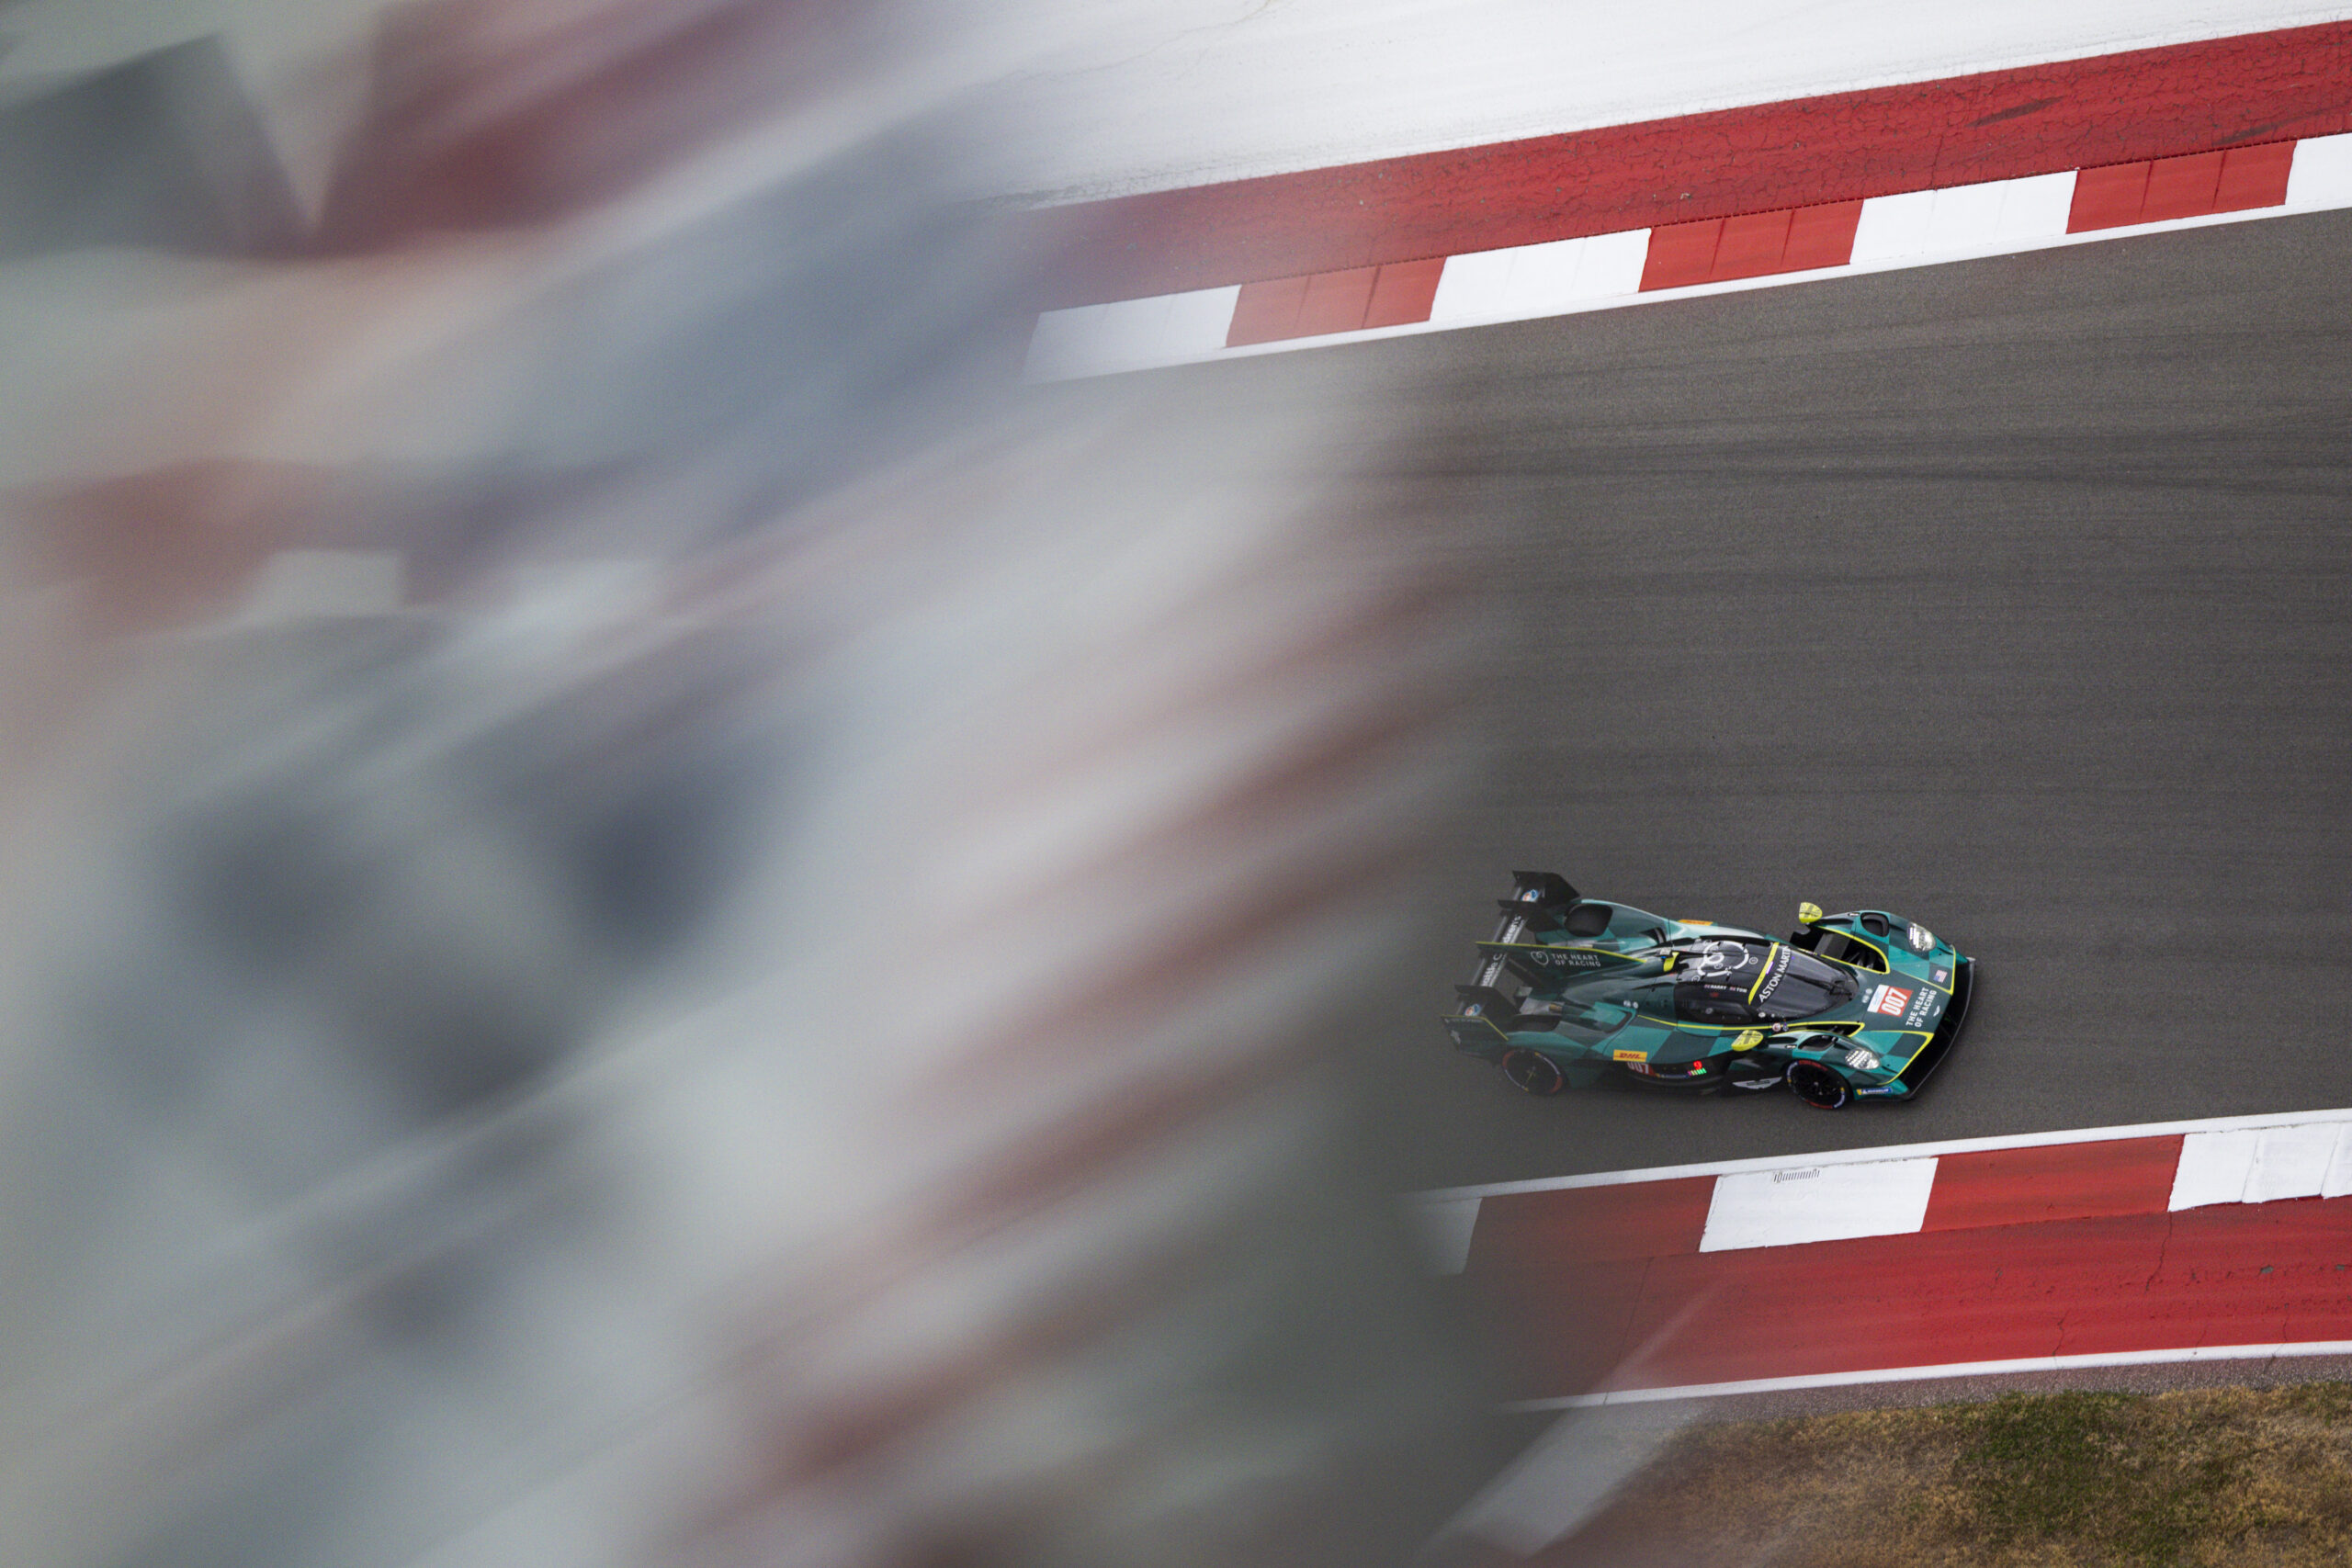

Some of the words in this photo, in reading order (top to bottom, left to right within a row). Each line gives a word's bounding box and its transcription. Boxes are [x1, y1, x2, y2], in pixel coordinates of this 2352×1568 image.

[1568, 960, 1601, 968] RACING
[1758, 974, 1782, 1003] ASTON
[1881, 987, 1908, 1016] 007
[1905, 1011, 1918, 1026] THE
[1913, 987, 1929, 1010] HEART
[1914, 1015, 1924, 1028] OF
[1919, 990, 1938, 1016] RACING
[1693, 1060, 1702, 1070] 9
